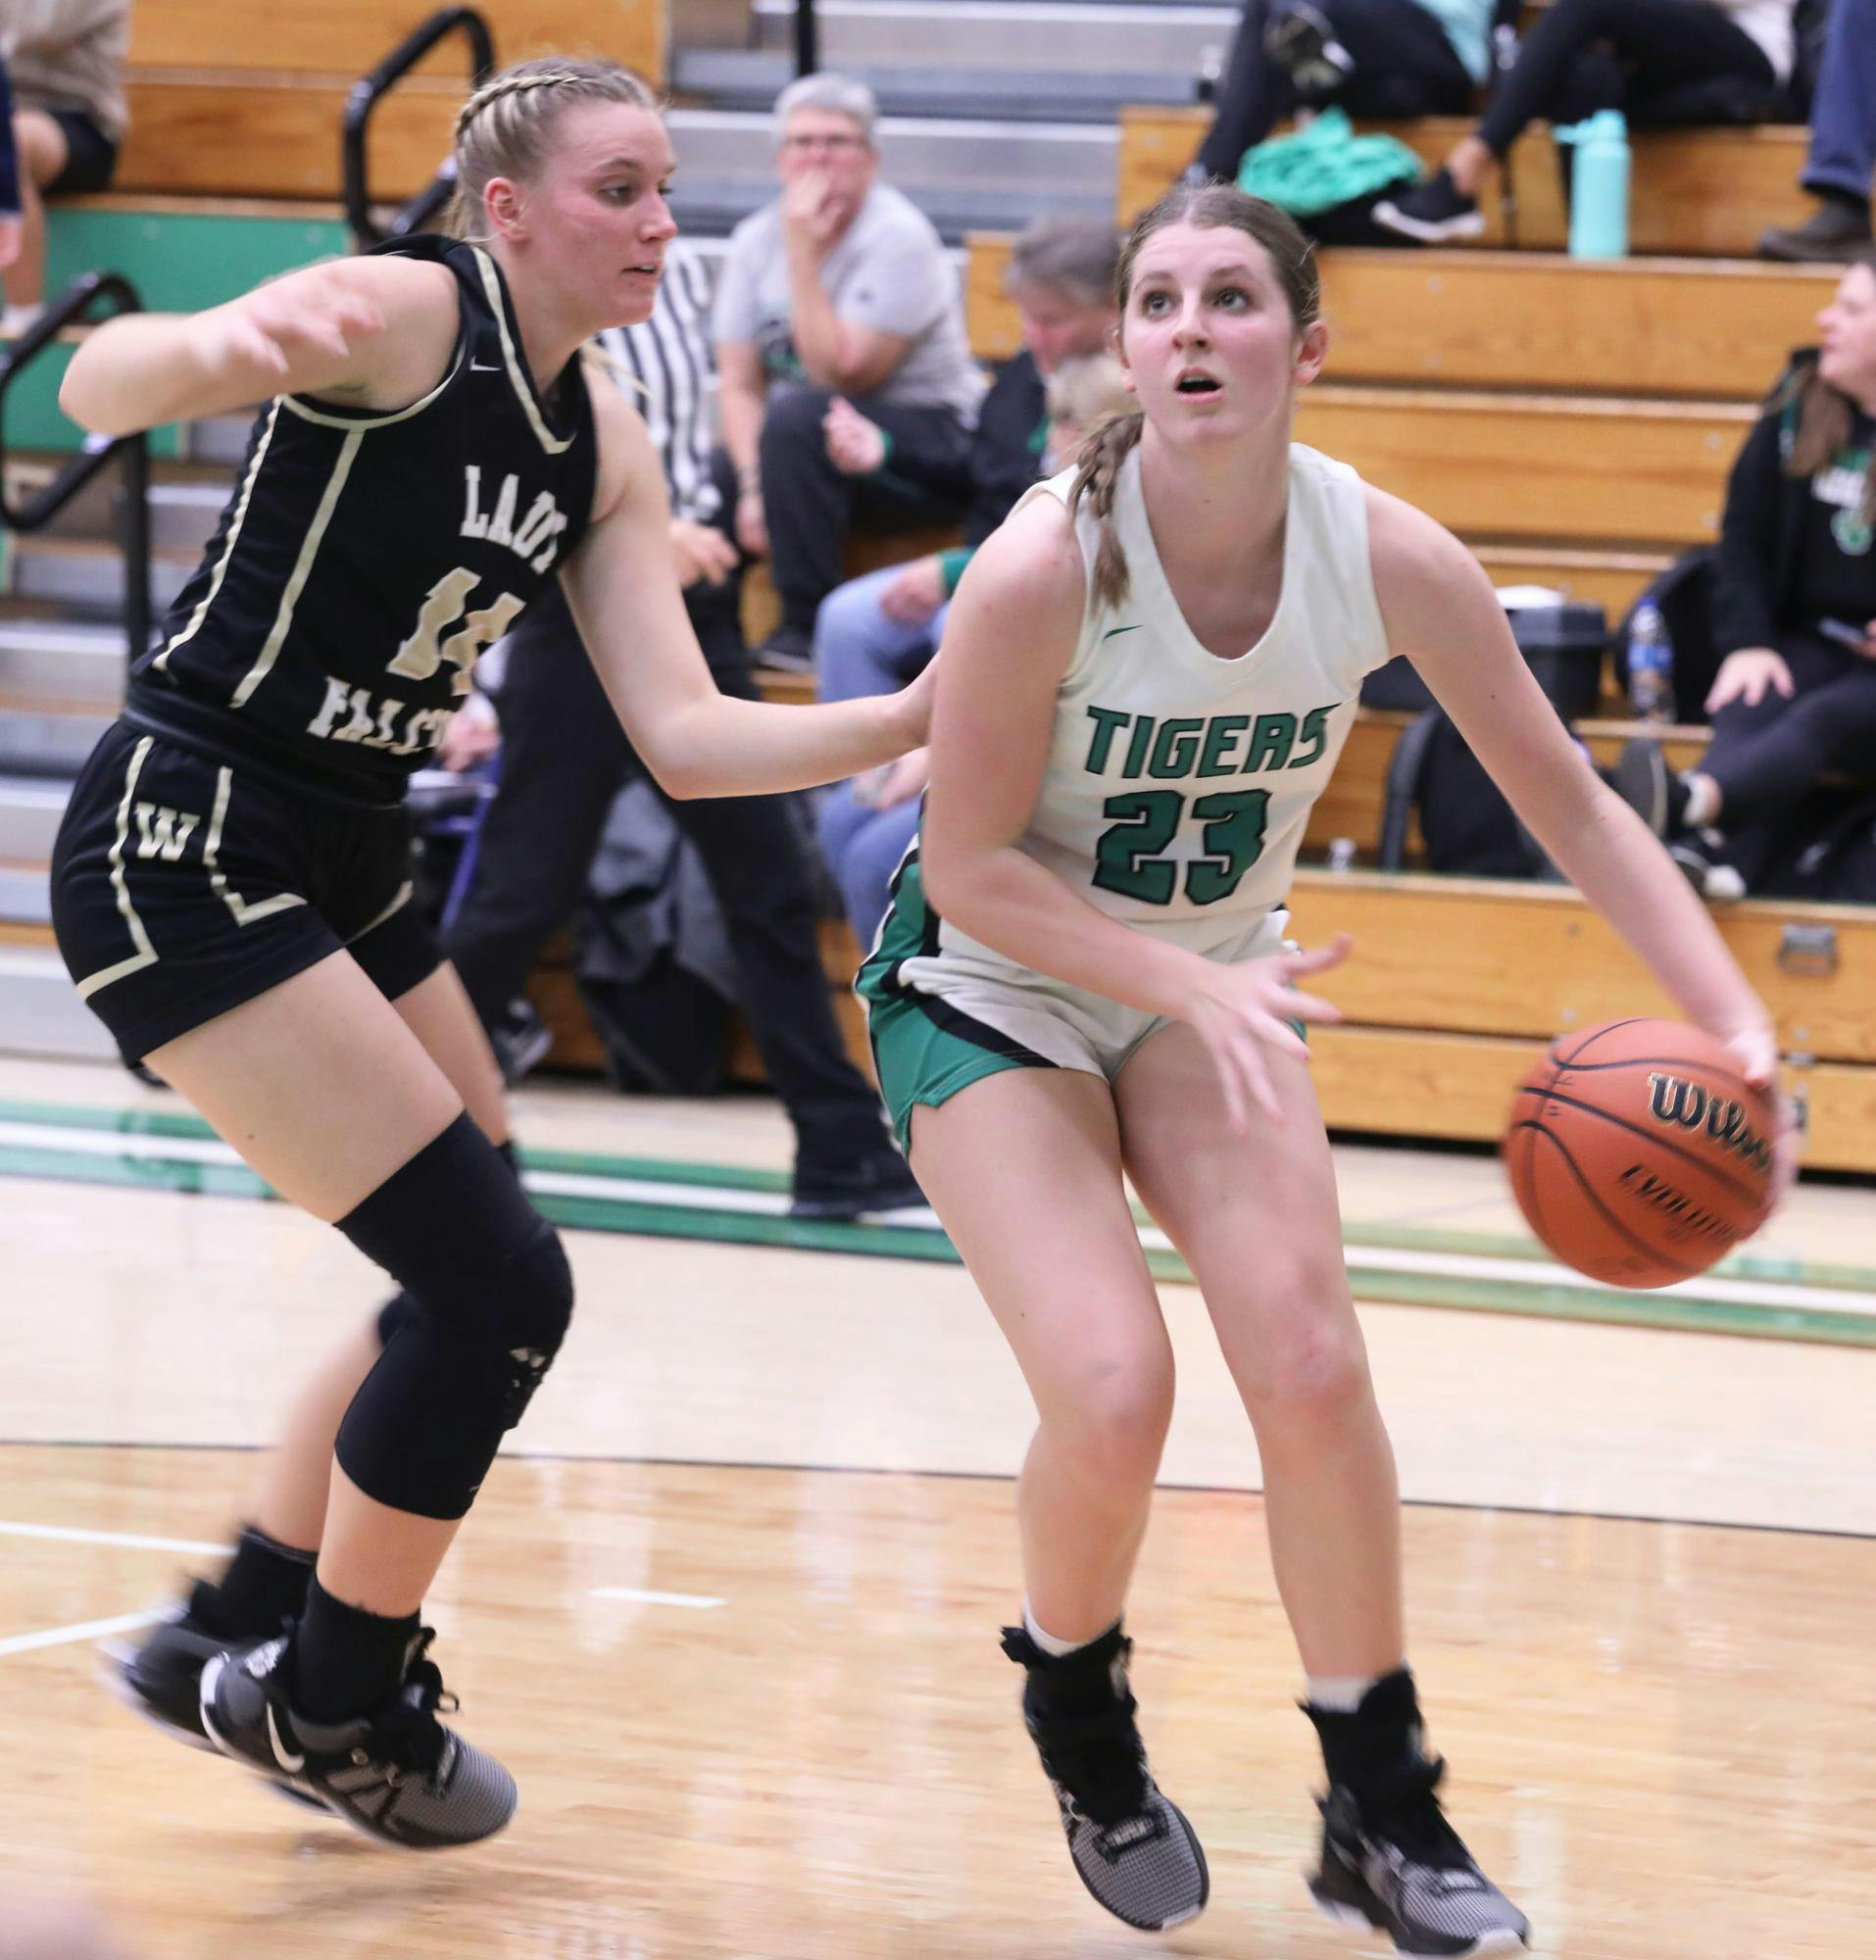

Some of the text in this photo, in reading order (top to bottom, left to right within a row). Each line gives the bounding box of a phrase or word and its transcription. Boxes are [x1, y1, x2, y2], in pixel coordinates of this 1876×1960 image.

[1084, 702, 1343, 779] TIGERS
[134, 801, 201, 861] W
[1091, 788, 1273, 906] 23
